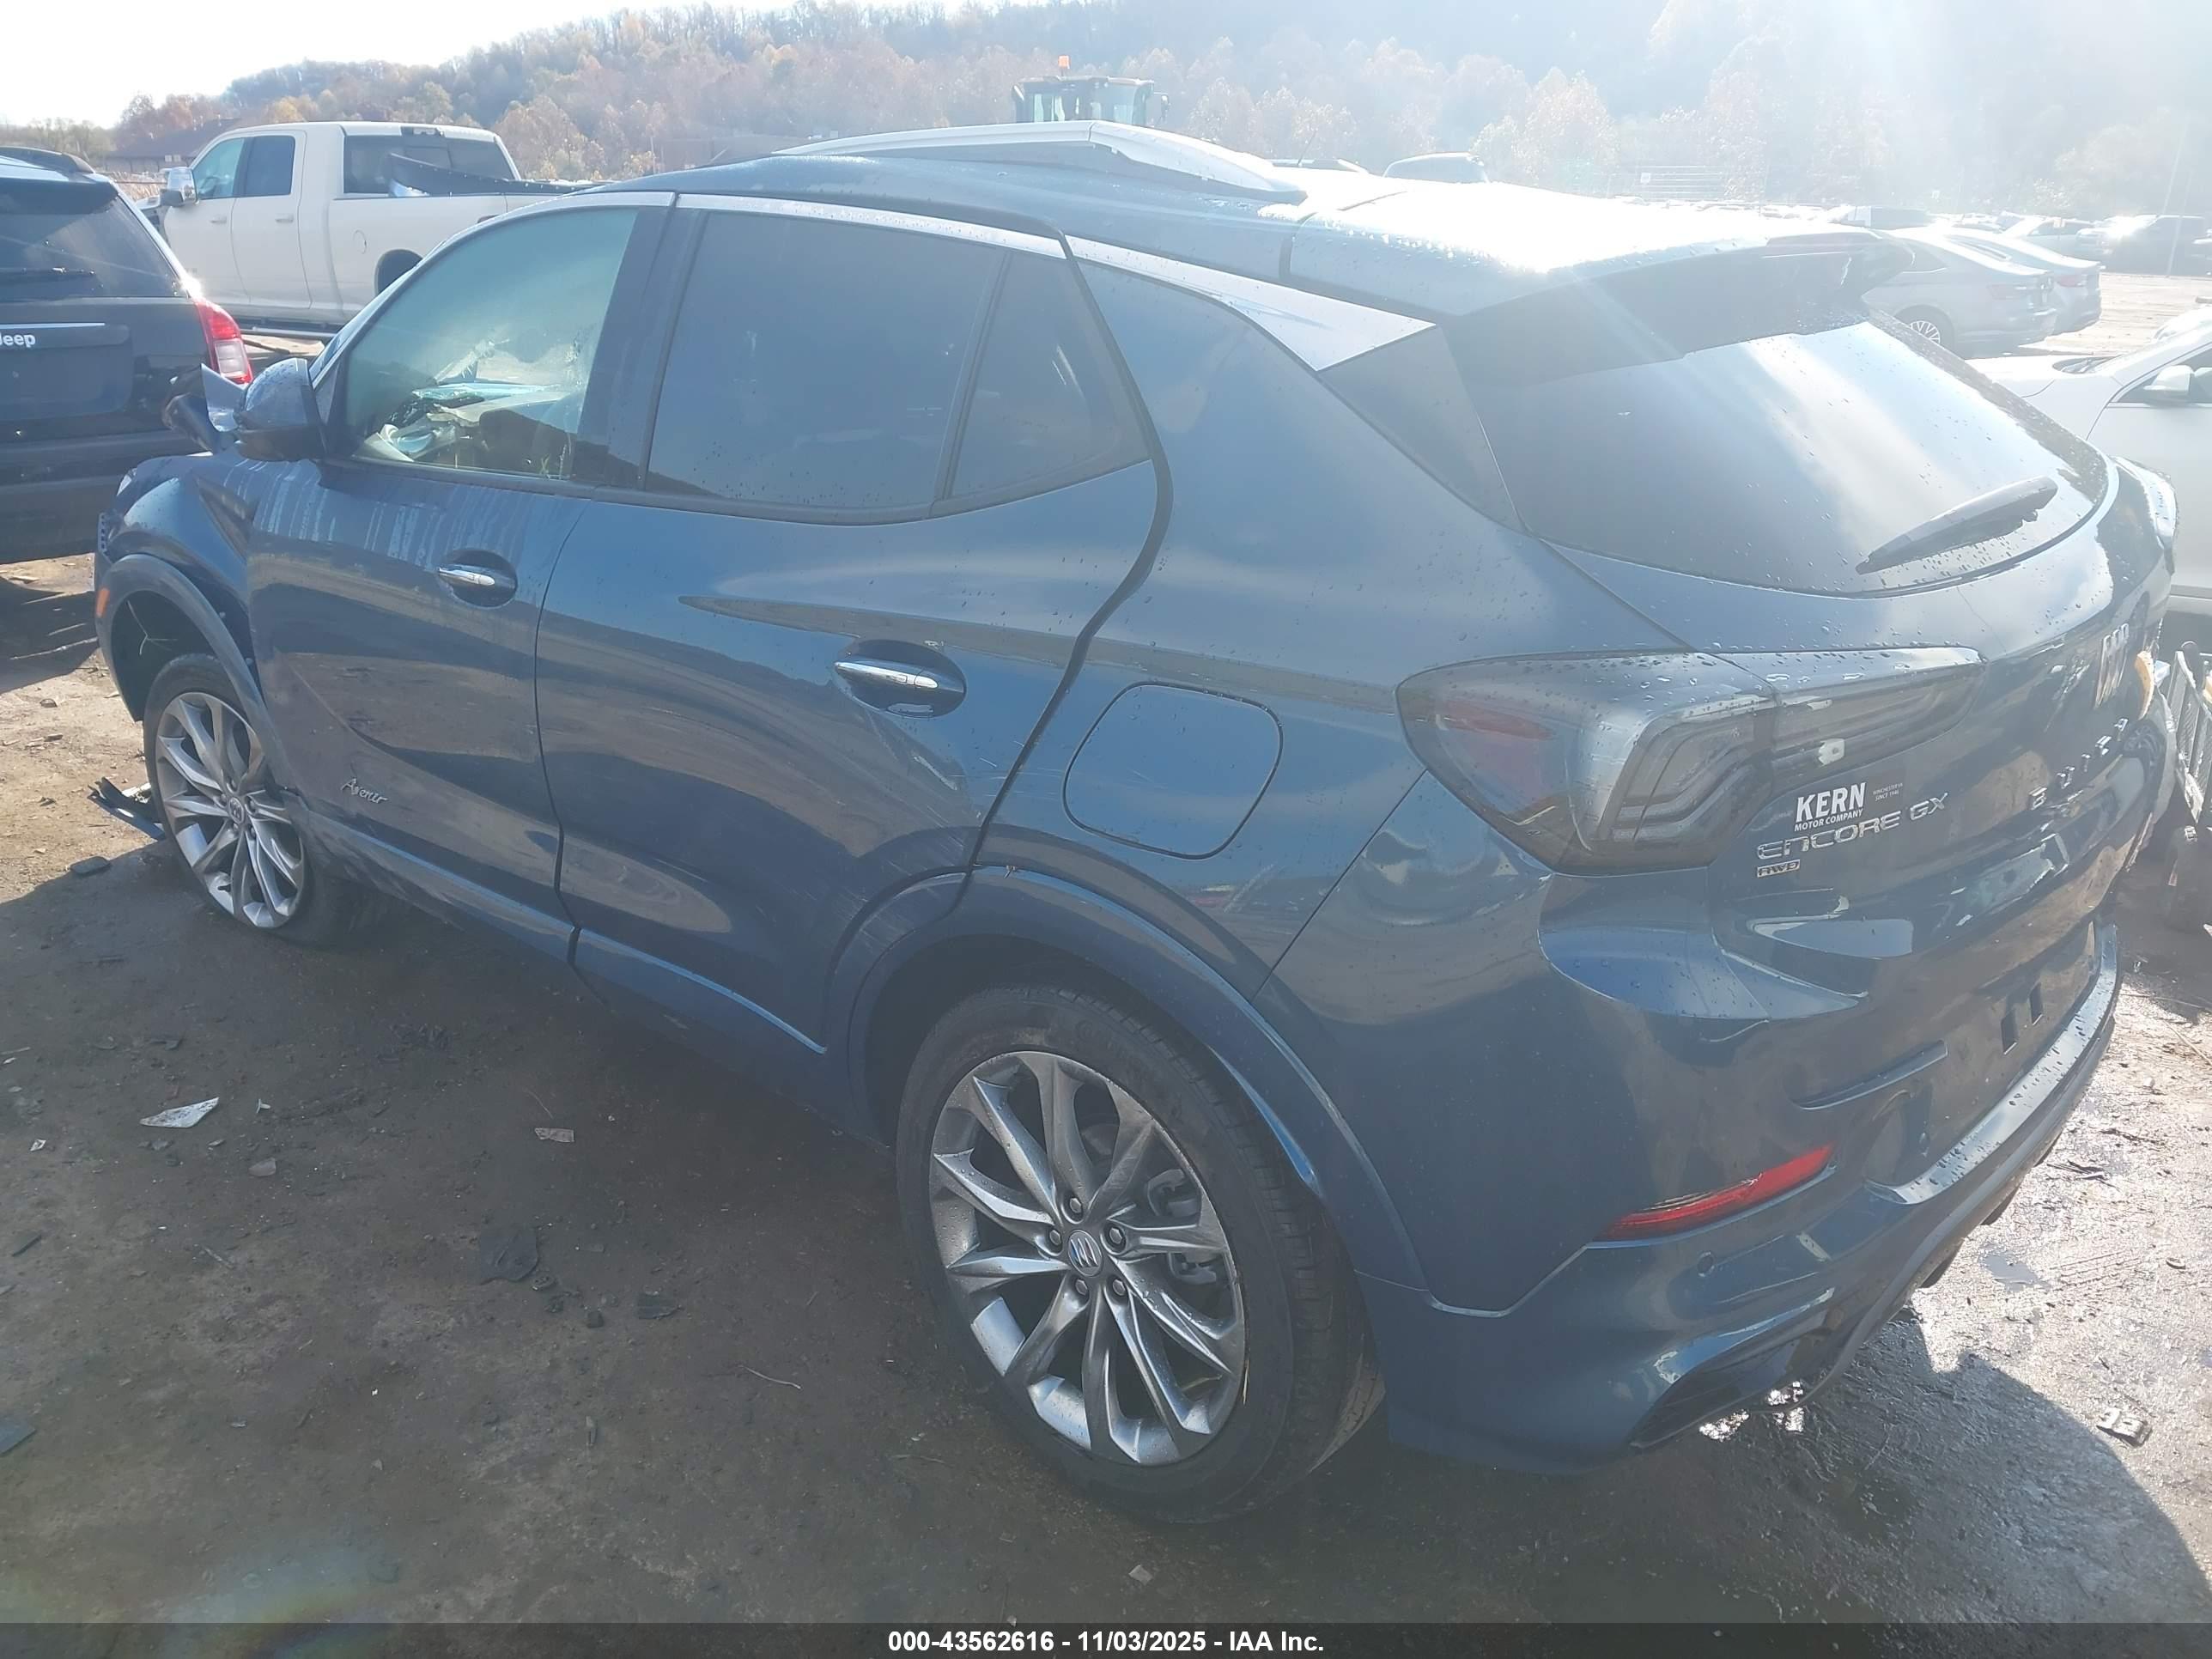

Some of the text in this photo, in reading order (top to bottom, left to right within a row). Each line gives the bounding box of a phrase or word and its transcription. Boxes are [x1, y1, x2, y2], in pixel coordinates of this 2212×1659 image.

[340, 778, 389, 804] Avenir
[1795, 781, 1867, 823] KERN
[1757, 792, 1948, 860] ENCORE GX
[1794, 808, 1864, 832] MOTOR COMPANY
[1757, 860, 1801, 878] AWD
